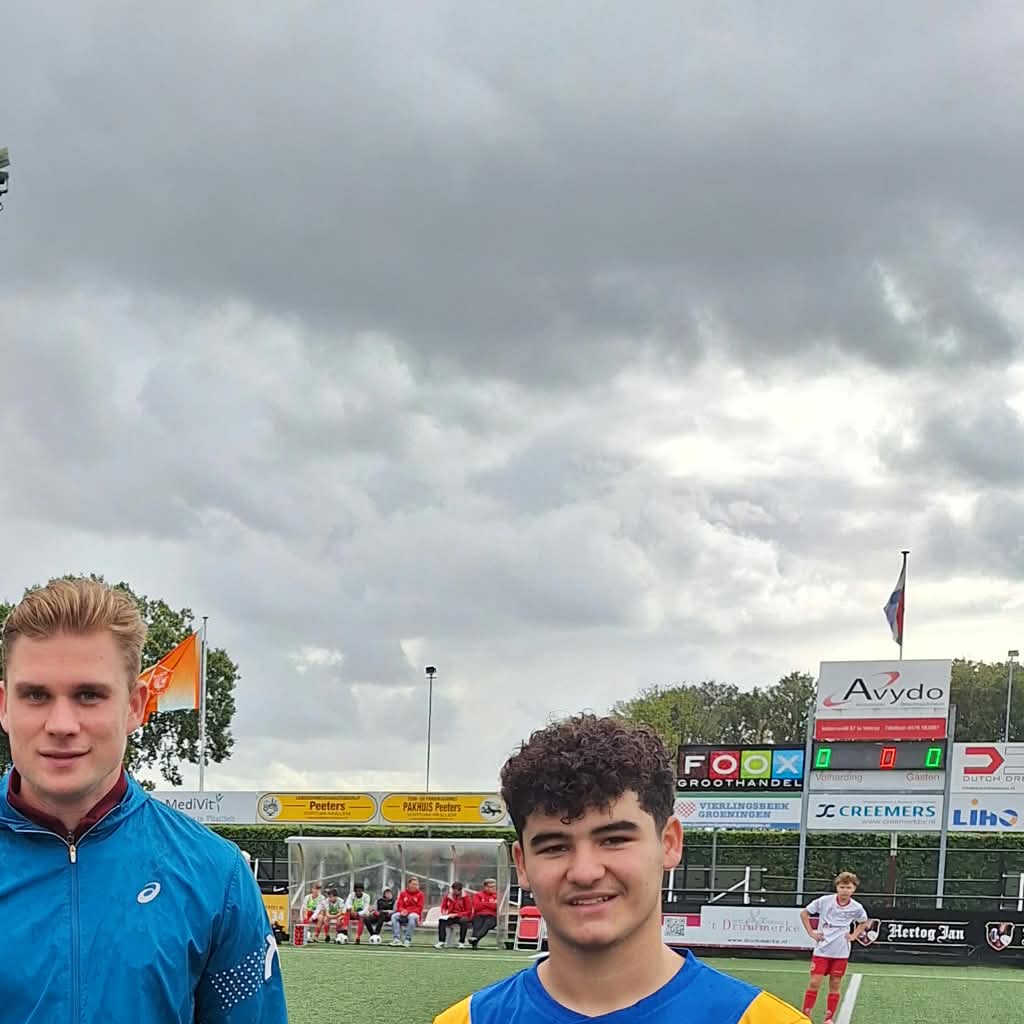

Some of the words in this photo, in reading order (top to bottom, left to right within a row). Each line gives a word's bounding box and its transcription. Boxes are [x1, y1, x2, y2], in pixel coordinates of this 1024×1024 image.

[843, 678, 944, 704] Avydo
[684, 754, 800, 775] FOOX
[815, 773, 863, 784] Volharding
[906, 772, 940, 783] Gasten
[677, 779, 803, 788] GROOTHANDEL
[309, 801, 346, 811] Peeters
[403, 801, 433, 812] PAKHUIS
[435, 802, 461, 813] Peeters
[699, 802, 789, 810] VIERLINGSBEEK
[839, 805, 936, 818] CREEMERS
[698, 810, 772, 818] GROENINGEN
[887, 923, 936, 941] Hertog
[936, 924, 965, 943] Jan
